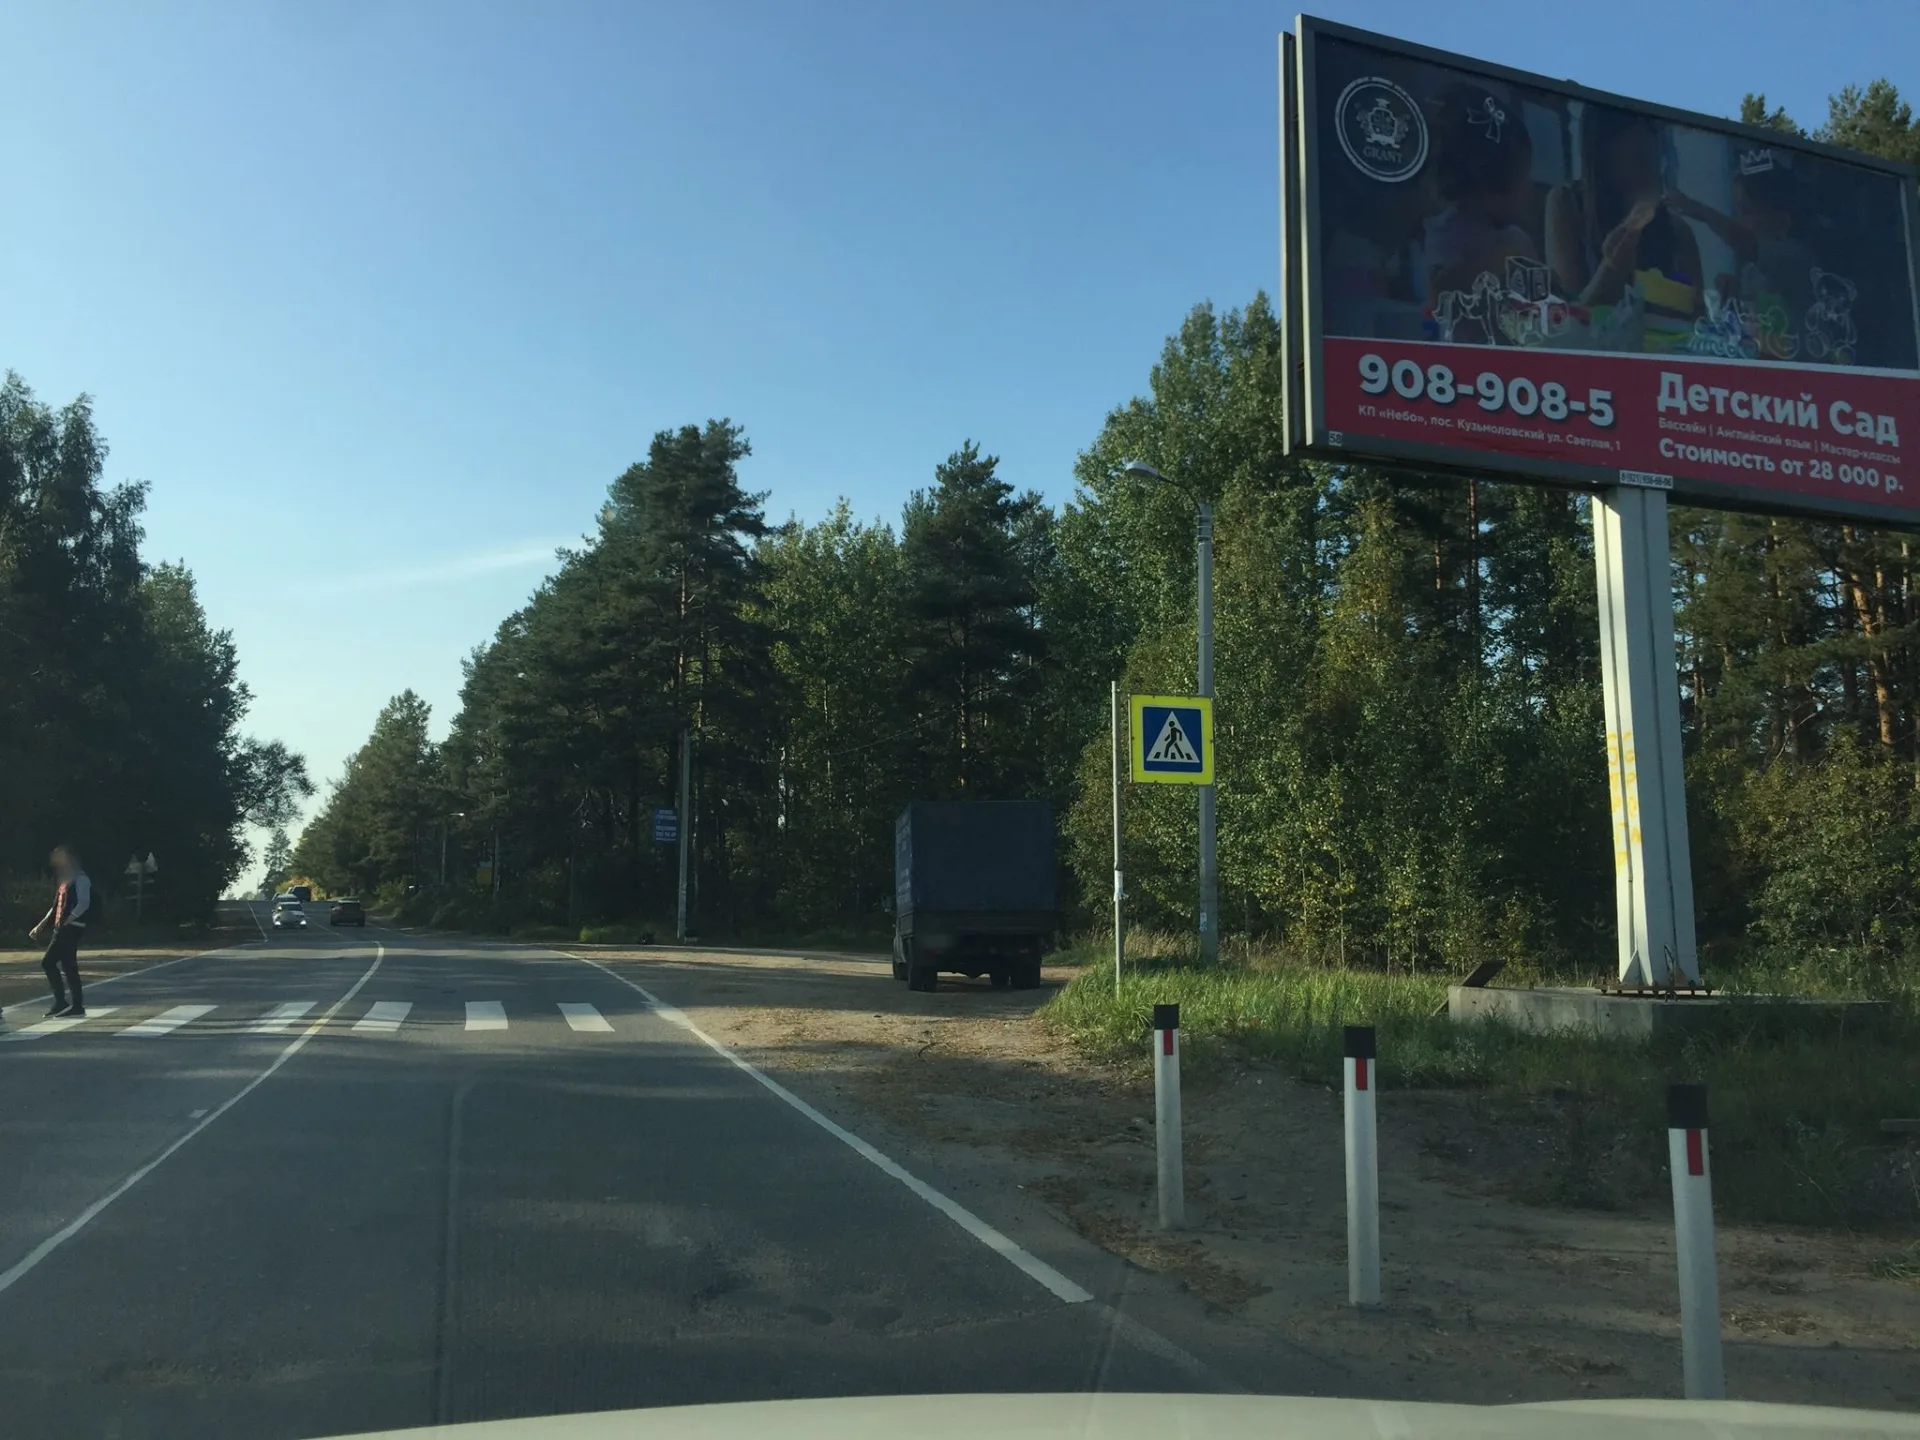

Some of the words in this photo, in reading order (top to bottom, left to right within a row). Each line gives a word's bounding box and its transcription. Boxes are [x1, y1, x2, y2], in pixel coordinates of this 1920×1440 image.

[1358, 354, 1614, 426] 908-908-5
[1657, 371, 1819, 430] Детский
[1829, 401, 1899, 448] Сад
[1358, 405, 1375, 417] КП
[1379, 409, 1428, 426] «Небо»,
[1430, 416, 1454, 428] пос.
[1457, 419, 1544, 441] Кузьмоловский
[1547, 433, 1563, 445] ул.
[1659, 438, 1775, 472] Стоимость
[1781, 459, 1804, 477] от
[1809, 459, 1833, 480] 28
[1839, 464, 1879, 488] 000
[1885, 474, 1904, 493] р.
